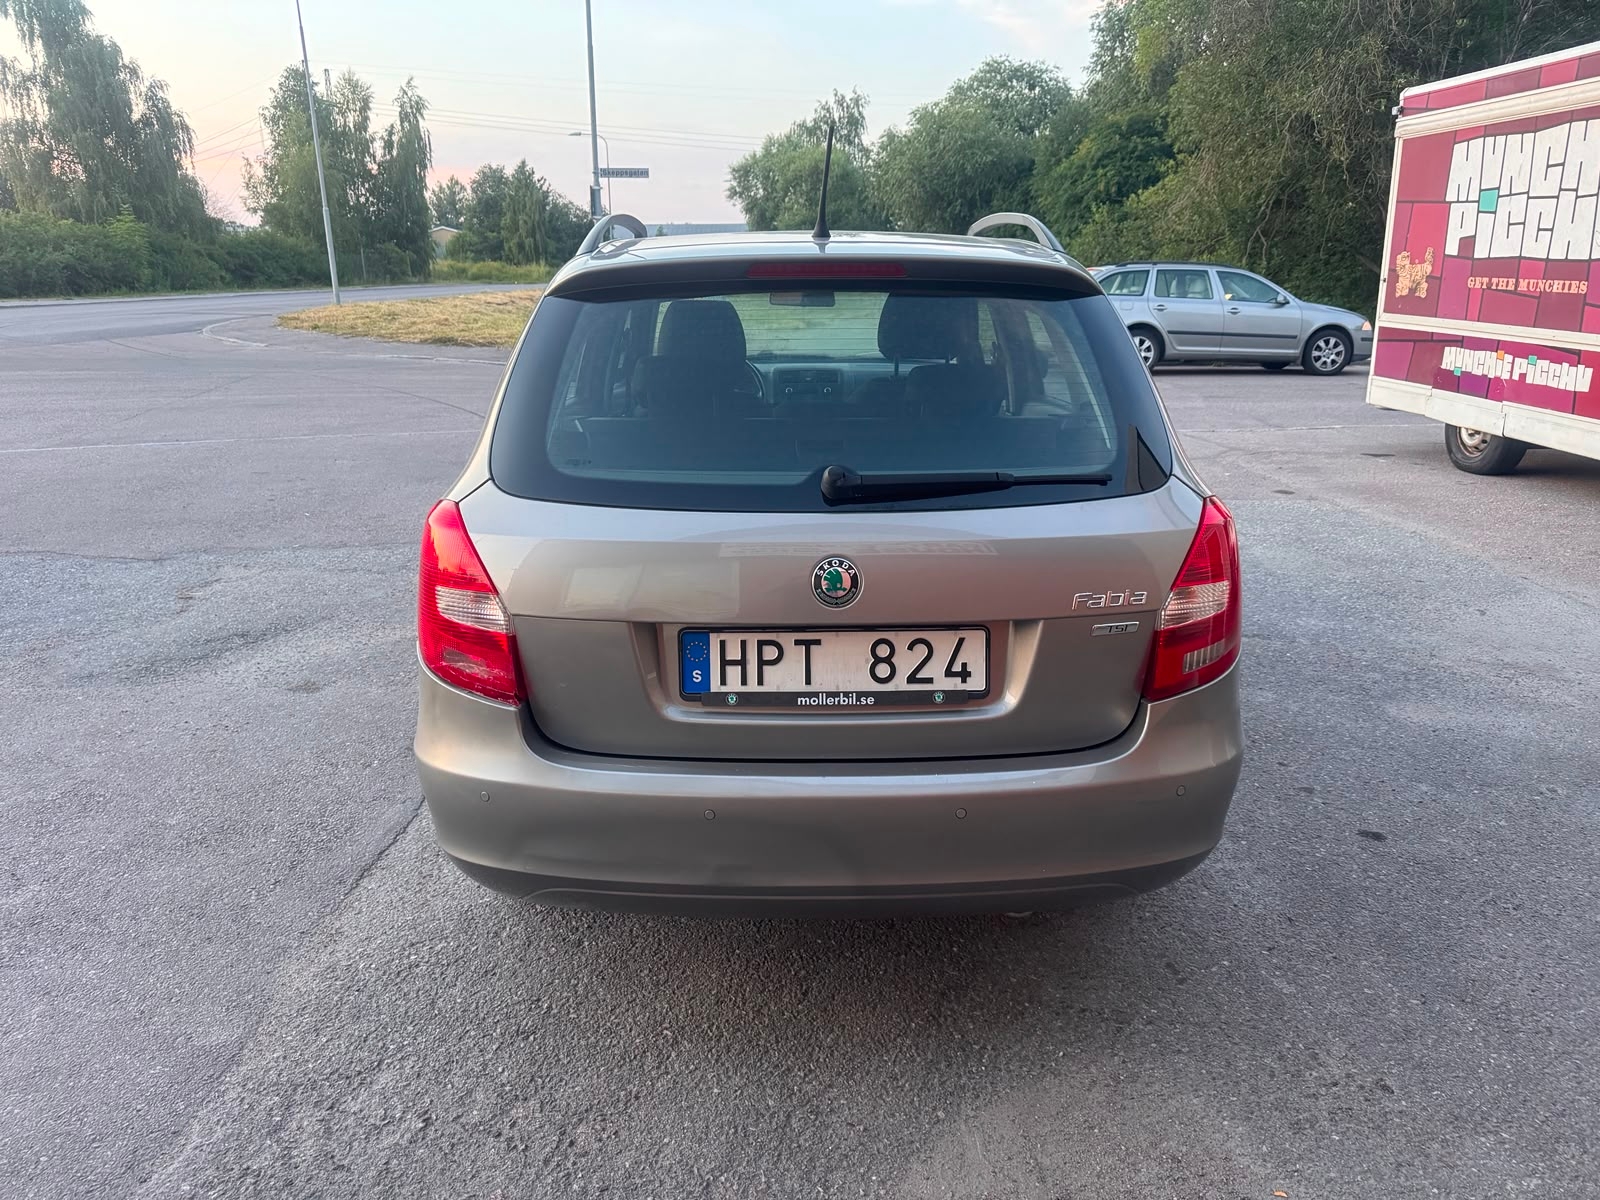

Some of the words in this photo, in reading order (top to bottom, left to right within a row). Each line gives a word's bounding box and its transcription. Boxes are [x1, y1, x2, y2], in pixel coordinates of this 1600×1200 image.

[1444, 191, 1600, 260] PICCH
[1467, 276, 1489, 289] GET
[1491, 277, 1515, 290] THE
[1518, 279, 1588, 294] MUNCHIES
[1441, 347, 1513, 380] MUNCHIE
[1512, 355, 1593, 392] PICCHU
[1072, 589, 1147, 610] Fabia
[1107, 624, 1129, 633] TSI
[718, 638, 822, 687] HPT
[868, 637, 972, 685] 824
[692, 669, 702, 683] S
[797, 692, 875, 706] mollerbil.se
